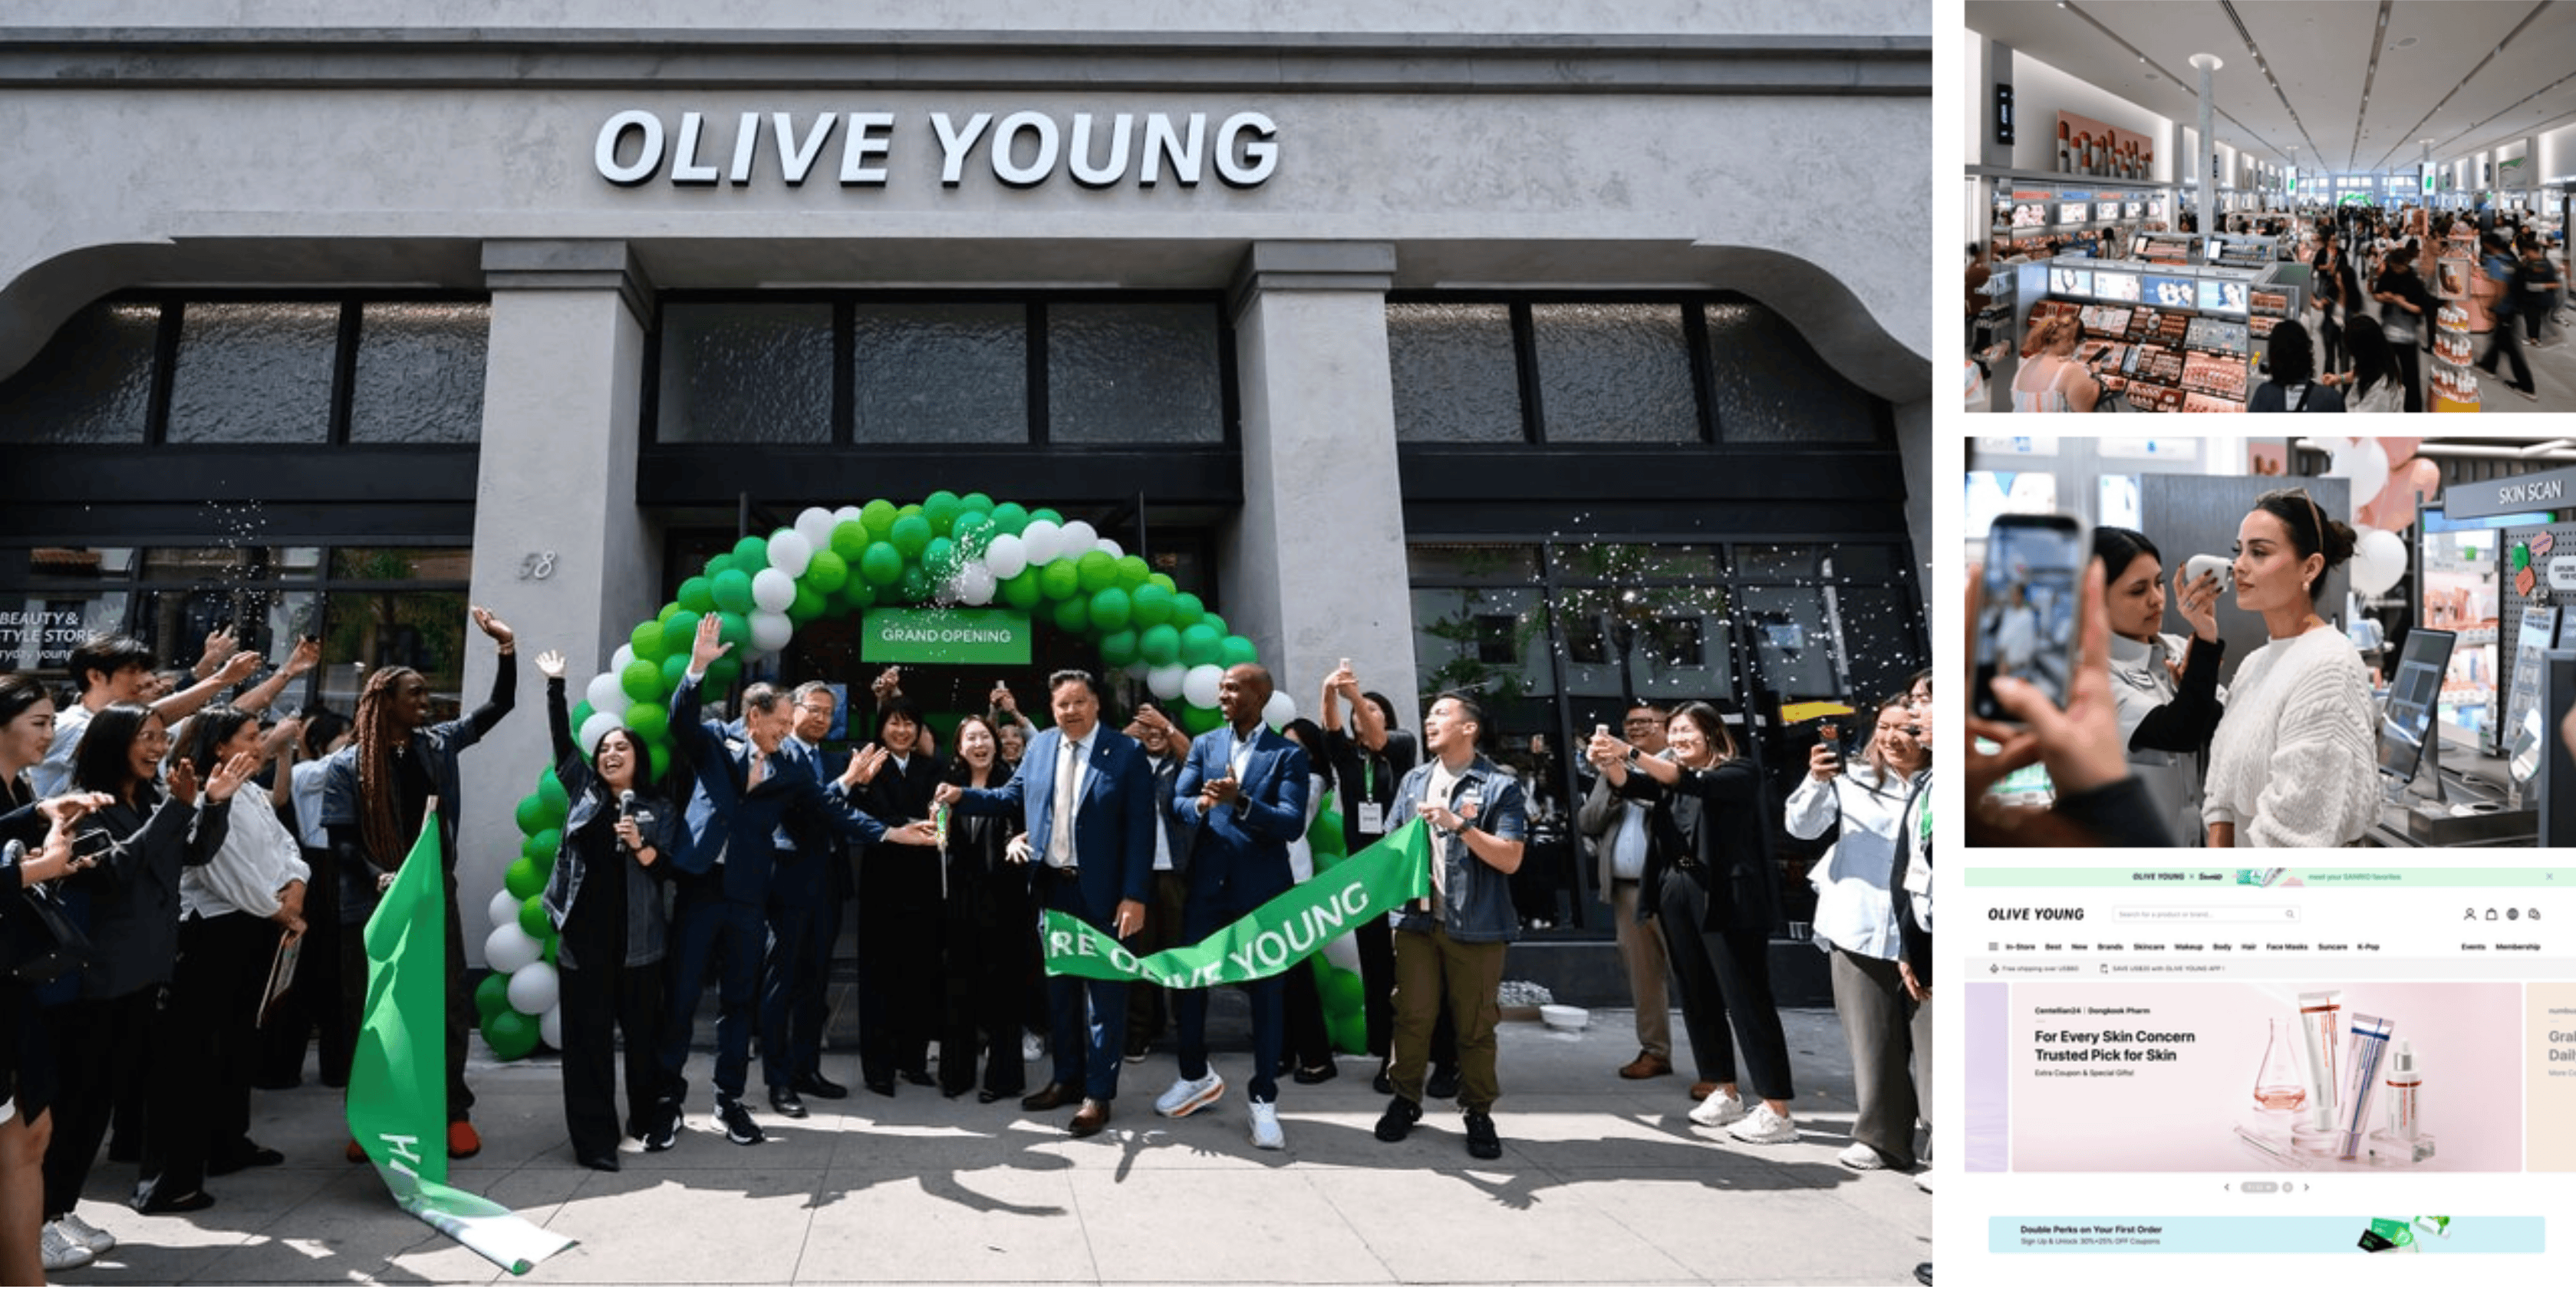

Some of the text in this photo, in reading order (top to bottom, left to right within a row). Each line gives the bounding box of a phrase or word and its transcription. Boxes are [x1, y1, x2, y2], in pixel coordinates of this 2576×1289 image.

[595, 110, 1279, 189] OLIVE YOUNG
[2499, 479, 2562, 505] SKIN SCAN
[0, 611, 78, 625] BEAUTY &
[0, 629, 97, 643] TYLE STORE
[882, 628, 1012, 643] GRAND OPENING
[2133, 872, 2156, 881] OLIVE
[2157, 872, 2185, 881] YOUNG
[1988, 908, 2084, 921] OLIVE YOUNG
[2157, 911, 2180, 919] product
[1229, 882, 1369, 978] YOUNG
[2005, 943, 2036, 951] In-Store
[2045, 943, 2062, 951] Best
[2071, 943, 2088, 951] New
[2097, 943, 2124, 951] Brands
[2133, 943, 2166, 951] Skincare
[2174, 943, 2204, 952] Makeup
[2212, 943, 2232, 952] Body
[2241, 943, 2258, 951] Hair
[2266, 943, 2308, 951] Face Masks
[2318, 943, 2348, 951] Suncare
[2357, 943, 2380, 952] K-Pop
[2461, 943, 2486, 951] Events
[2495, 943, 2541, 952] Membership
[2034, 1007, 2151, 1017] Centellian24 Dongkook Pharm
[2034, 1030, 2196, 1046] For Every Skin Concern
[2035, 1048, 2176, 1062] Trusted Pick for Skin
[2548, 1048, 2576, 1063] Dail
[2054, 1070, 2080, 1078] Coupon
[2090, 1070, 2114, 1078] Special
[2021, 1225, 2051, 1234] Double
[2053, 1225, 2078, 1234] Perks
[2093, 1225, 2113, 1234] Your
[2115, 1225, 2136, 1234] First
[2137, 1225, 2163, 1234] Order
[2021, 1238, 2035, 1246] Sign
[2037, 1238, 2047, 1246] Up
[2130, 1238, 2161, 1246] Coupons
